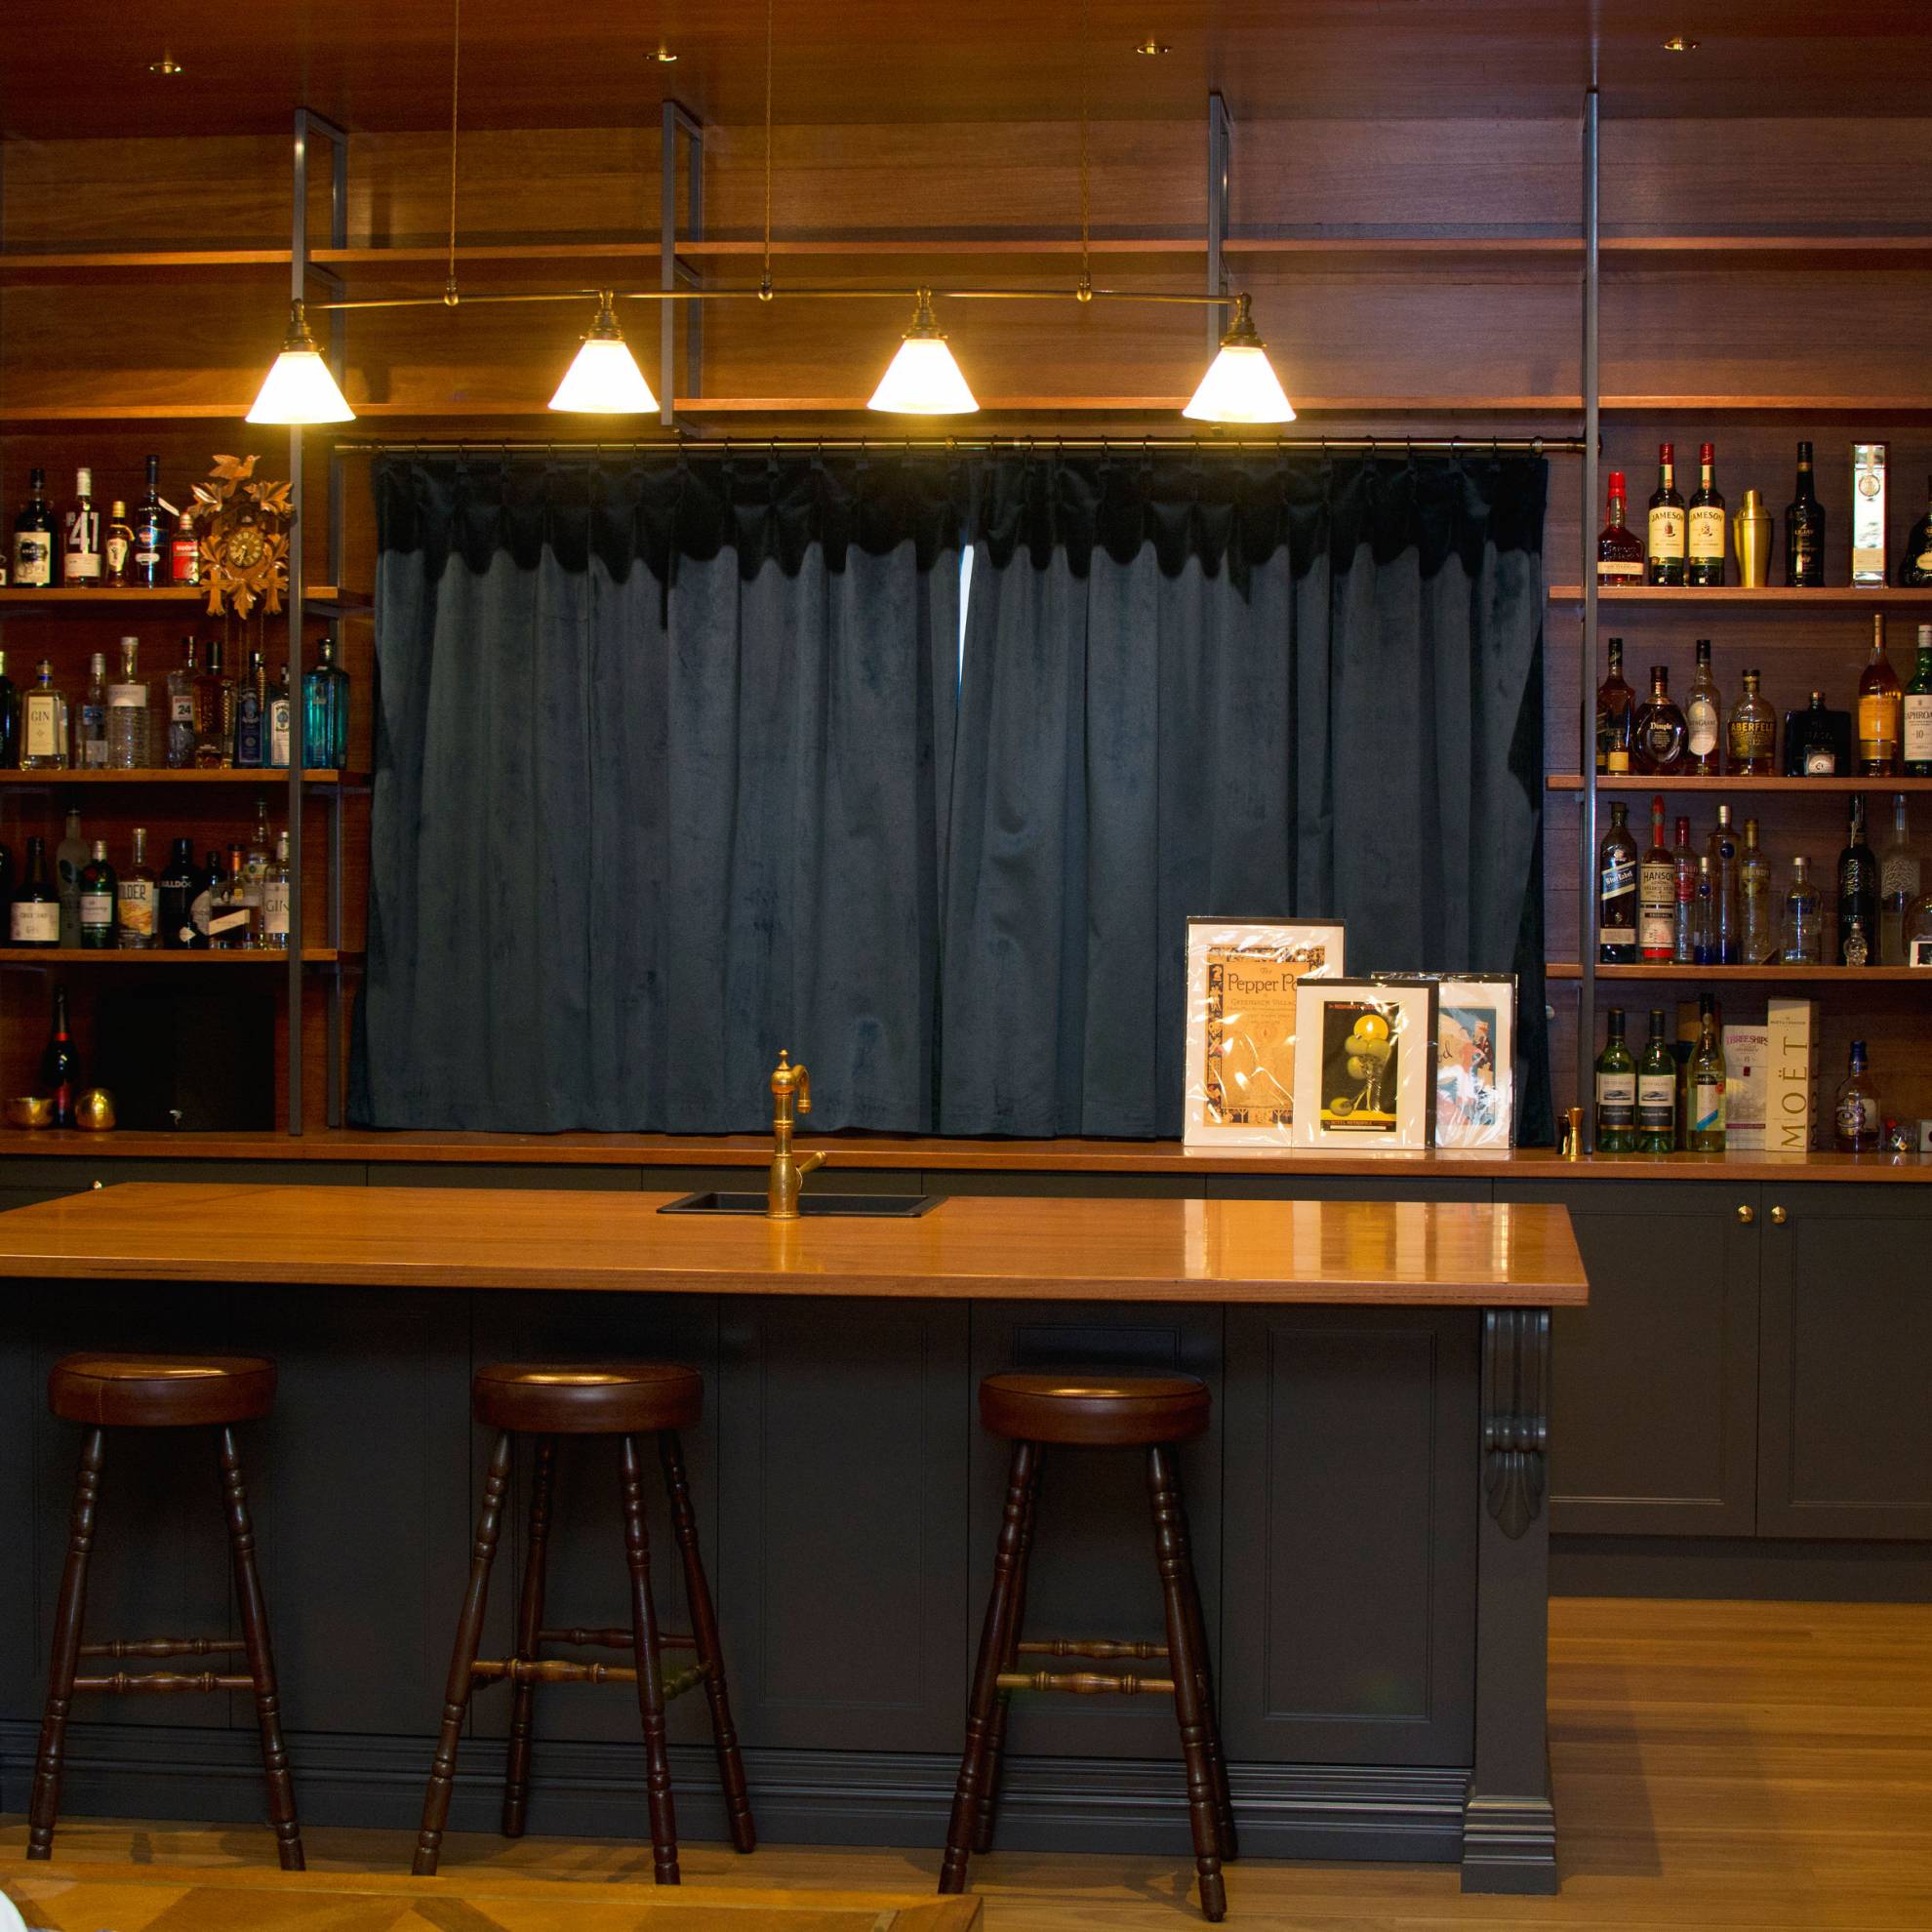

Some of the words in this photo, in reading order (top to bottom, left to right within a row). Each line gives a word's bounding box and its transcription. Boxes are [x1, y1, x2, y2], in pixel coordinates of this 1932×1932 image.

[1651, 510, 1684, 522] JAMESON
[1690, 510, 1723, 522] JAMESON
[69, 511, 100, 552] 41
[178, 704, 190, 715] 24
[31, 710, 49, 722] GIN
[1618, 869, 1633, 881] Label
[1228, 973, 1279, 994] Pepper
[1281, 973, 1297, 991] Po
[1726, 1034, 1749, 1046] THREE
[1750, 1035, 1768, 1046] SHIPS
[1778, 1035, 1807, 1148] MOËT
